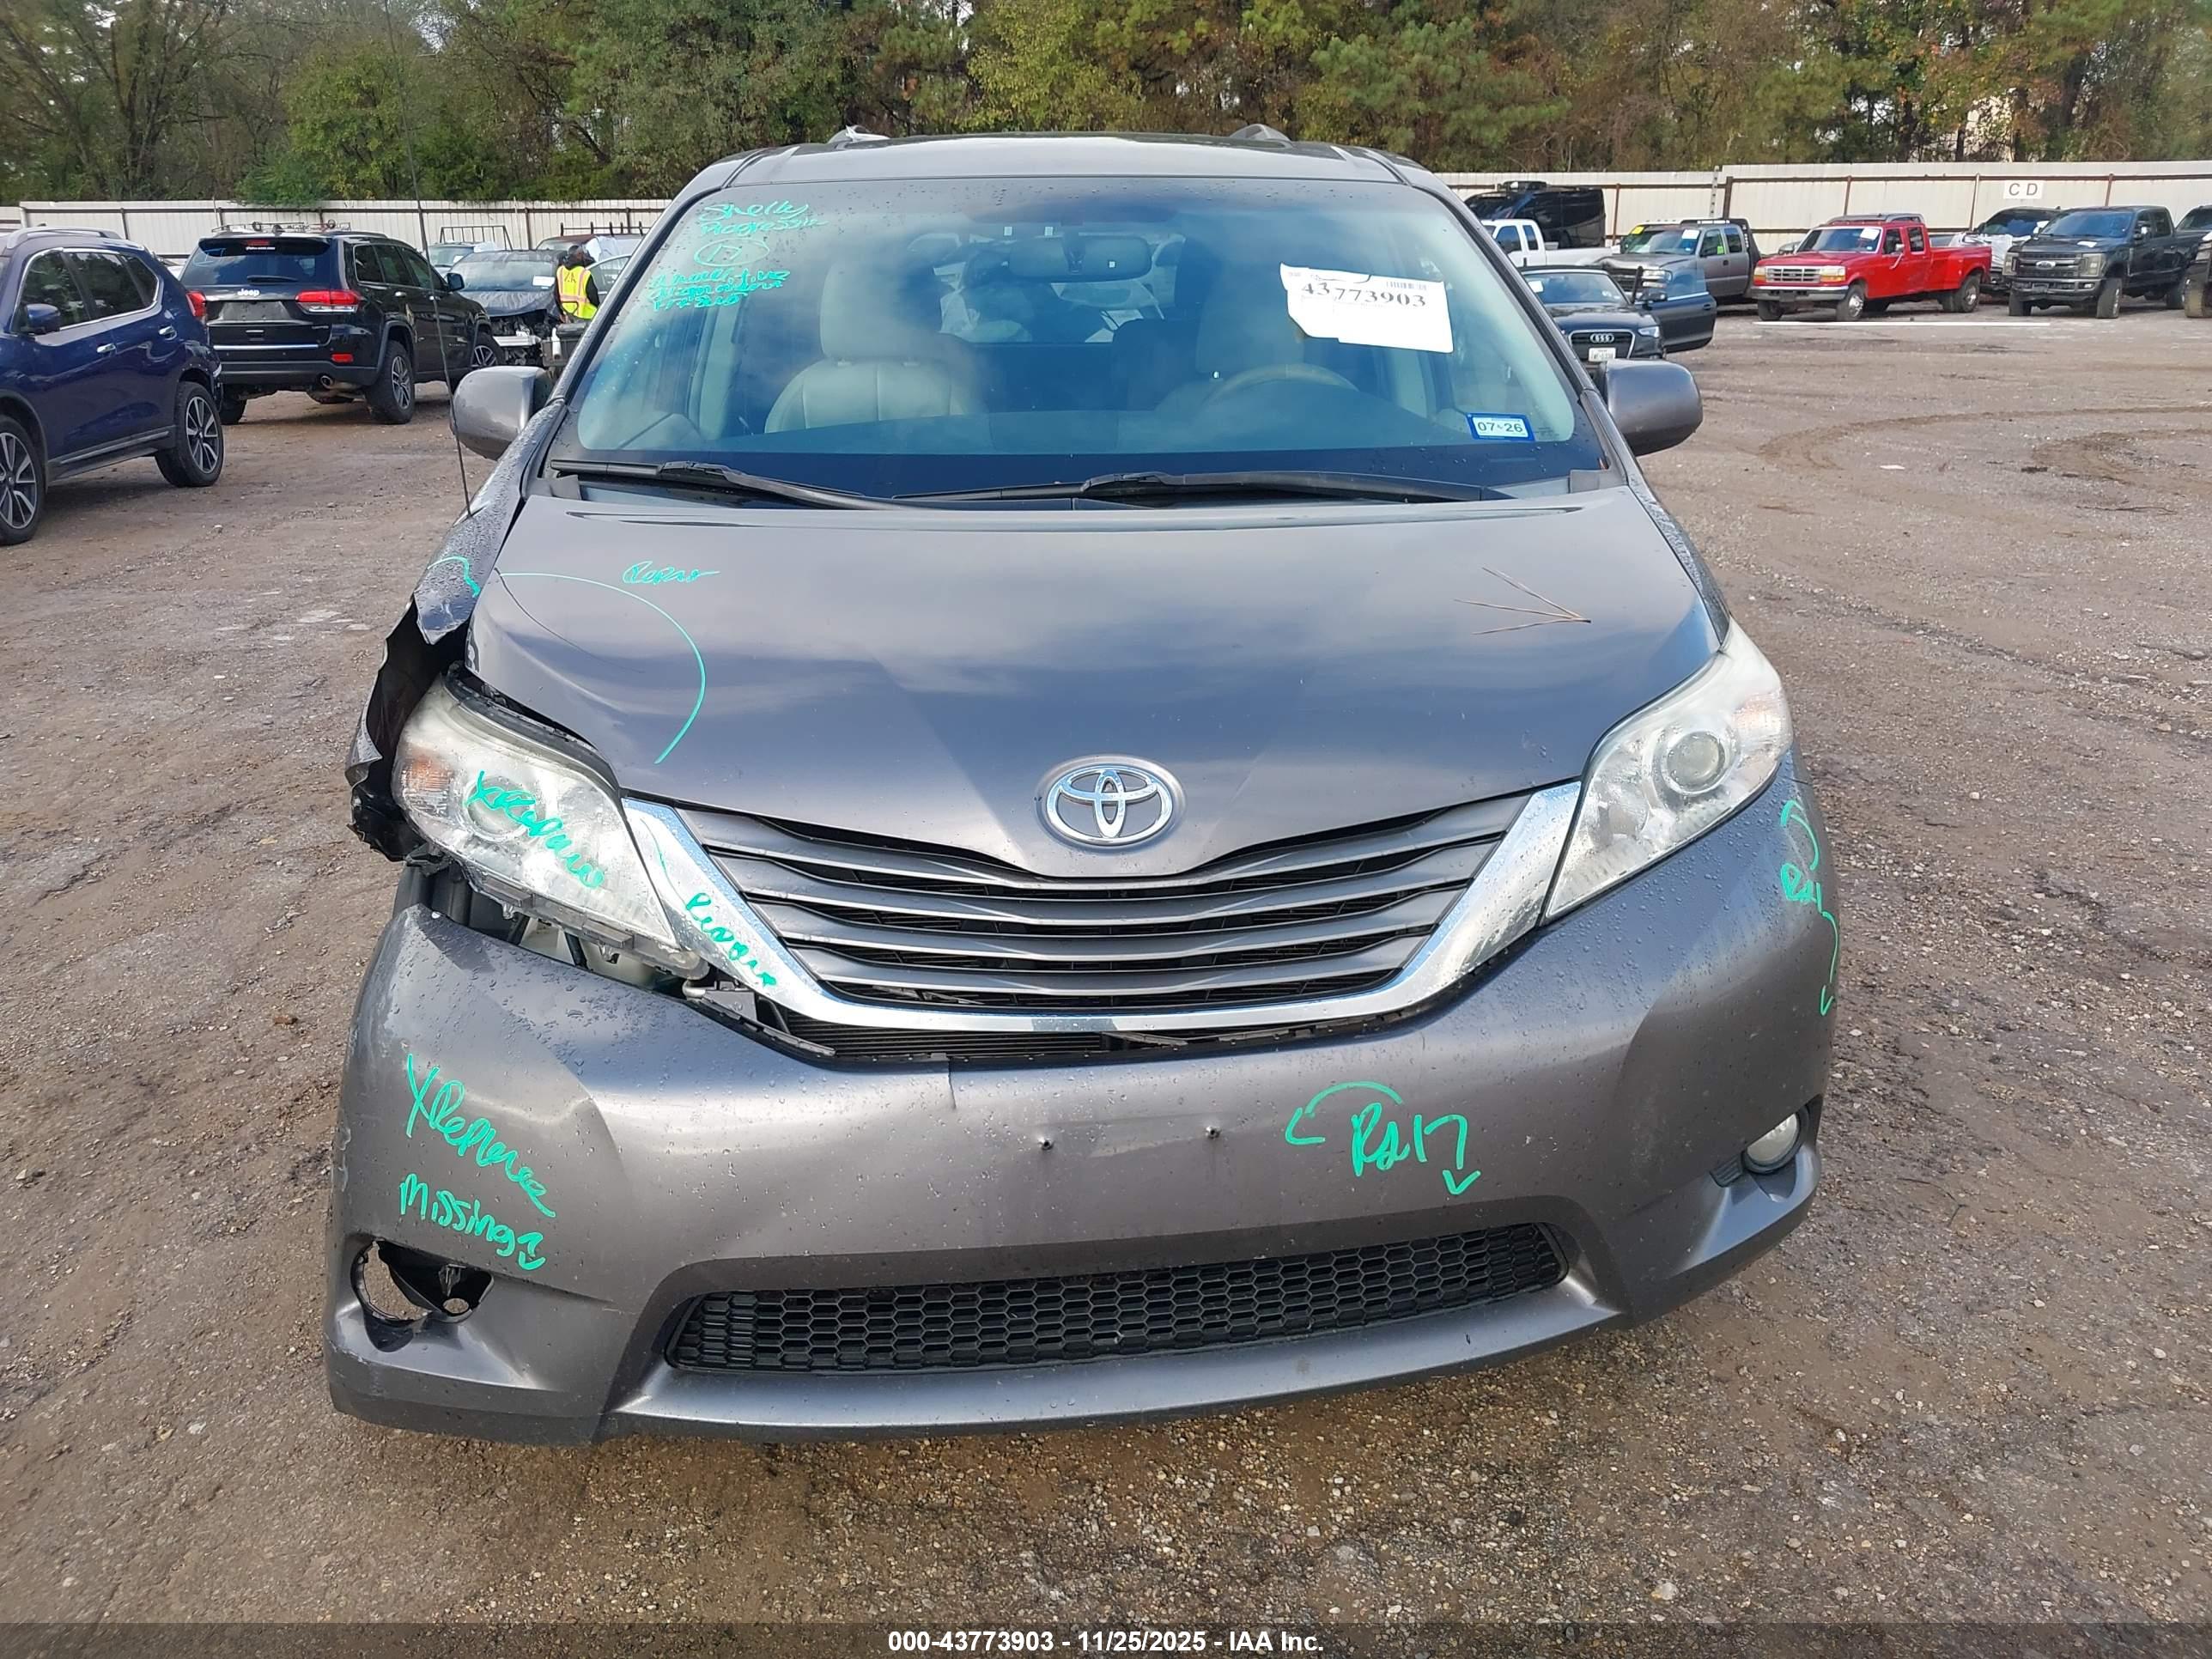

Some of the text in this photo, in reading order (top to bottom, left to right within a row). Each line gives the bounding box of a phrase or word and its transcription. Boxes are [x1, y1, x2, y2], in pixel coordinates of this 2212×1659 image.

[2008, 182, 2038, 196] C D
[237, 288, 260, 297] Jeep
[1301, 282, 1426, 307] 43773903
[1477, 422, 1496, 432] 07
[1504, 422, 1523, 433] 26
